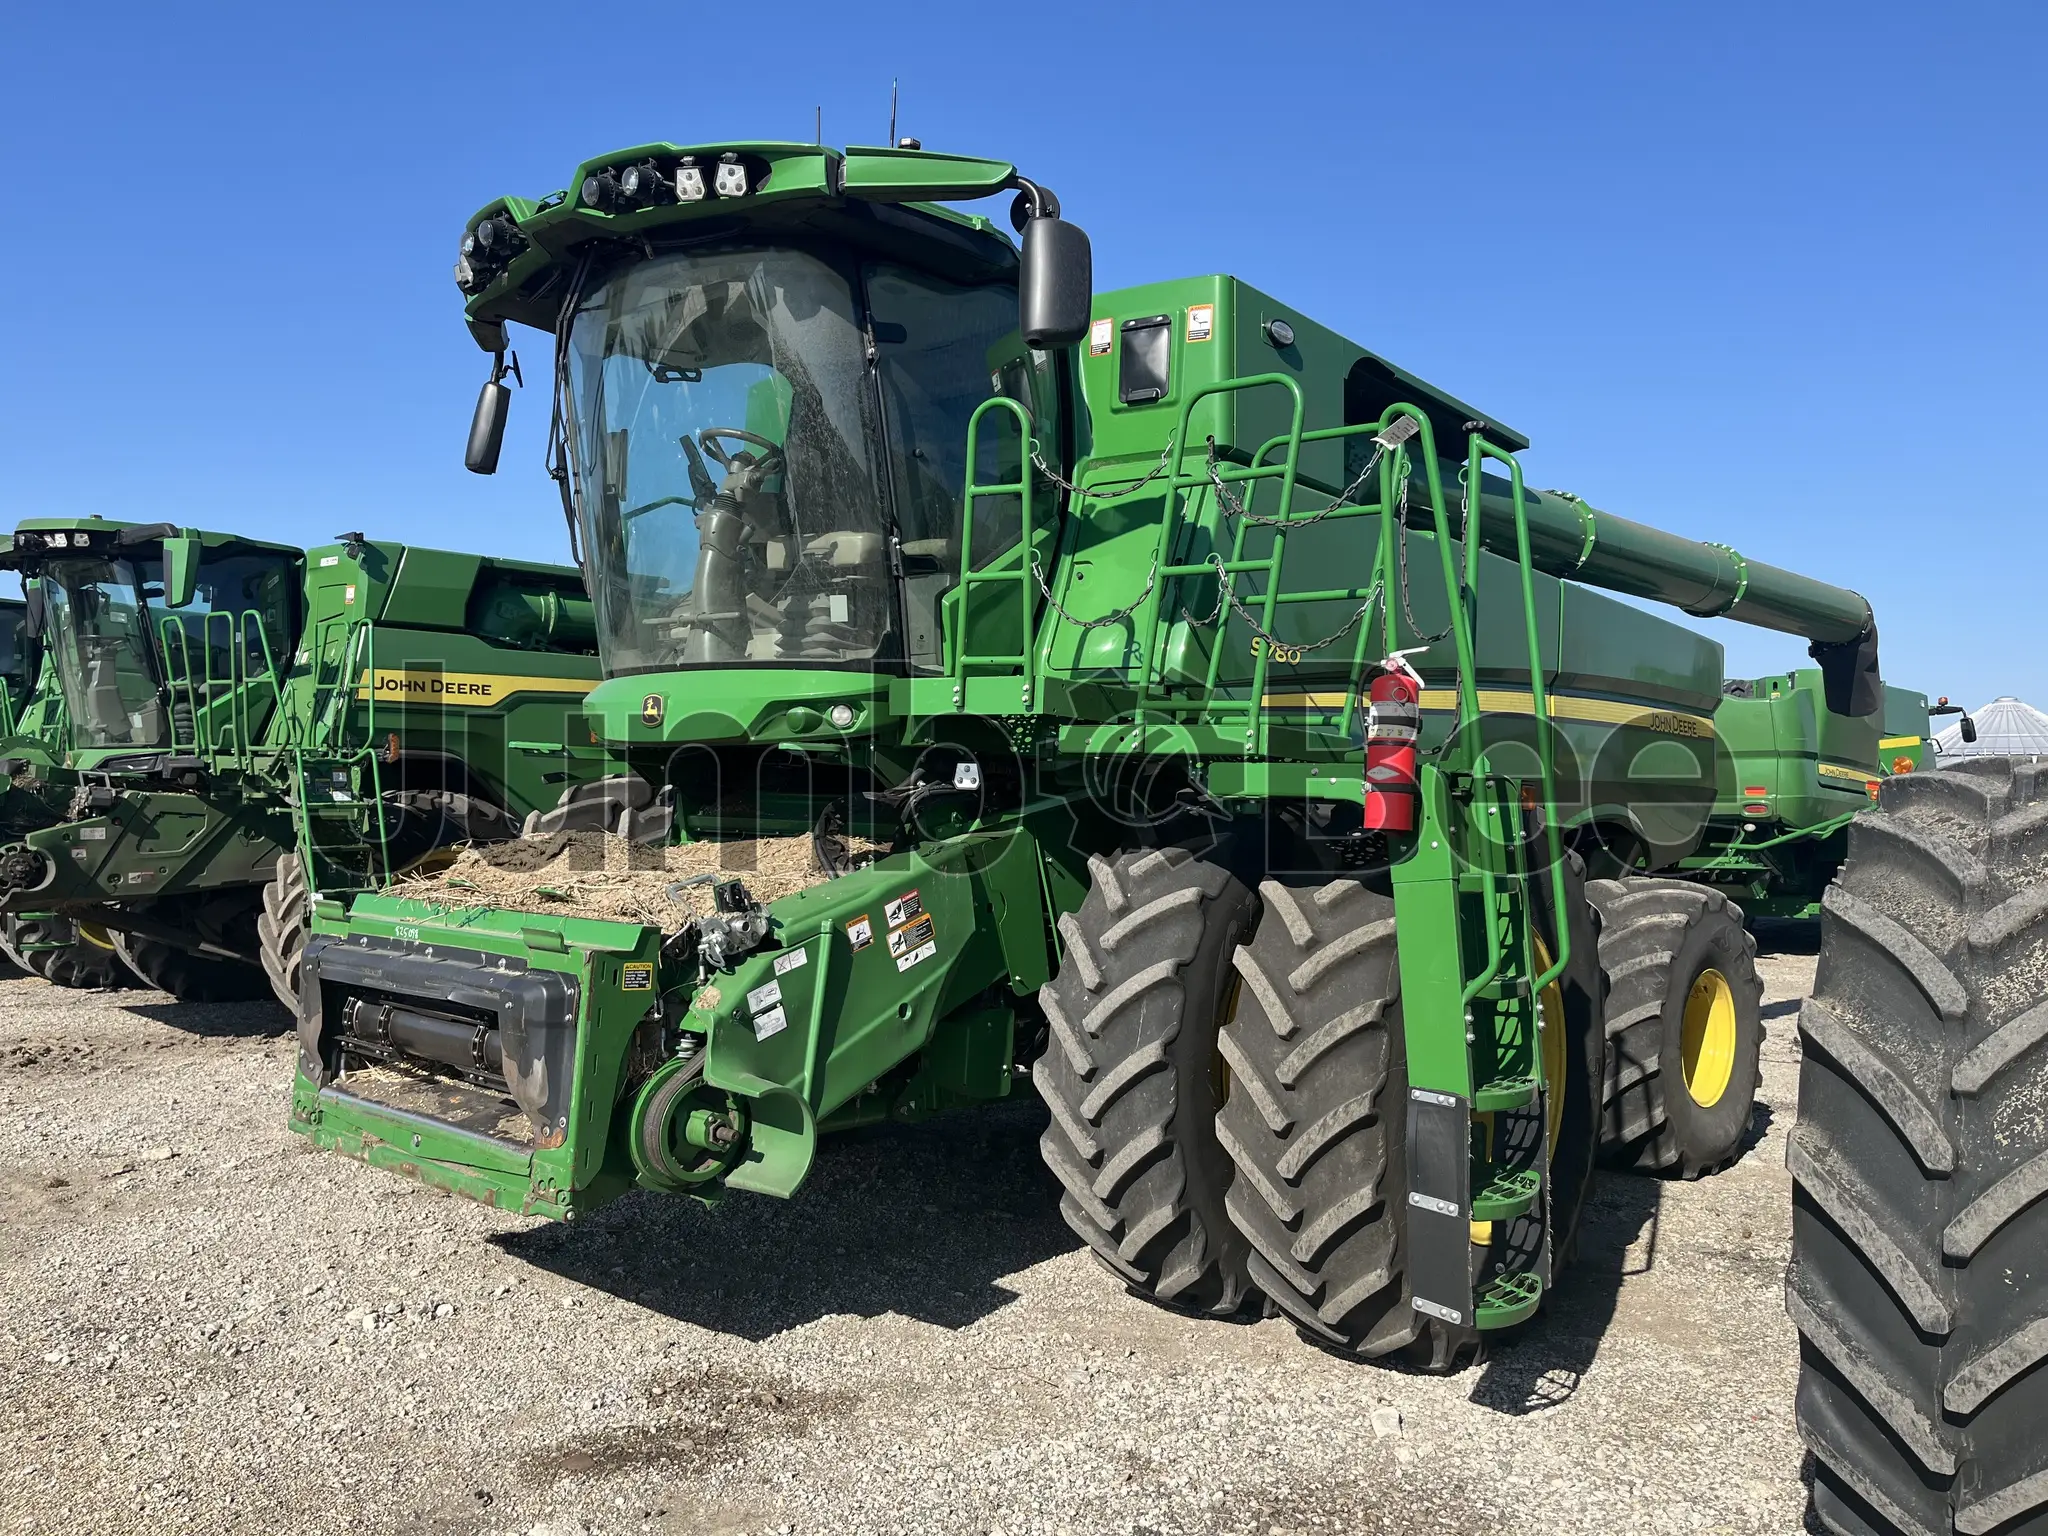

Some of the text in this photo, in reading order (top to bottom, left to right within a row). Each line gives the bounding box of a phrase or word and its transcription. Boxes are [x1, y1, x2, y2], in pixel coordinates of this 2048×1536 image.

[374, 676, 492, 696] JOHN DEERE
[1650, 711, 1698, 735] JOHN DEERE
